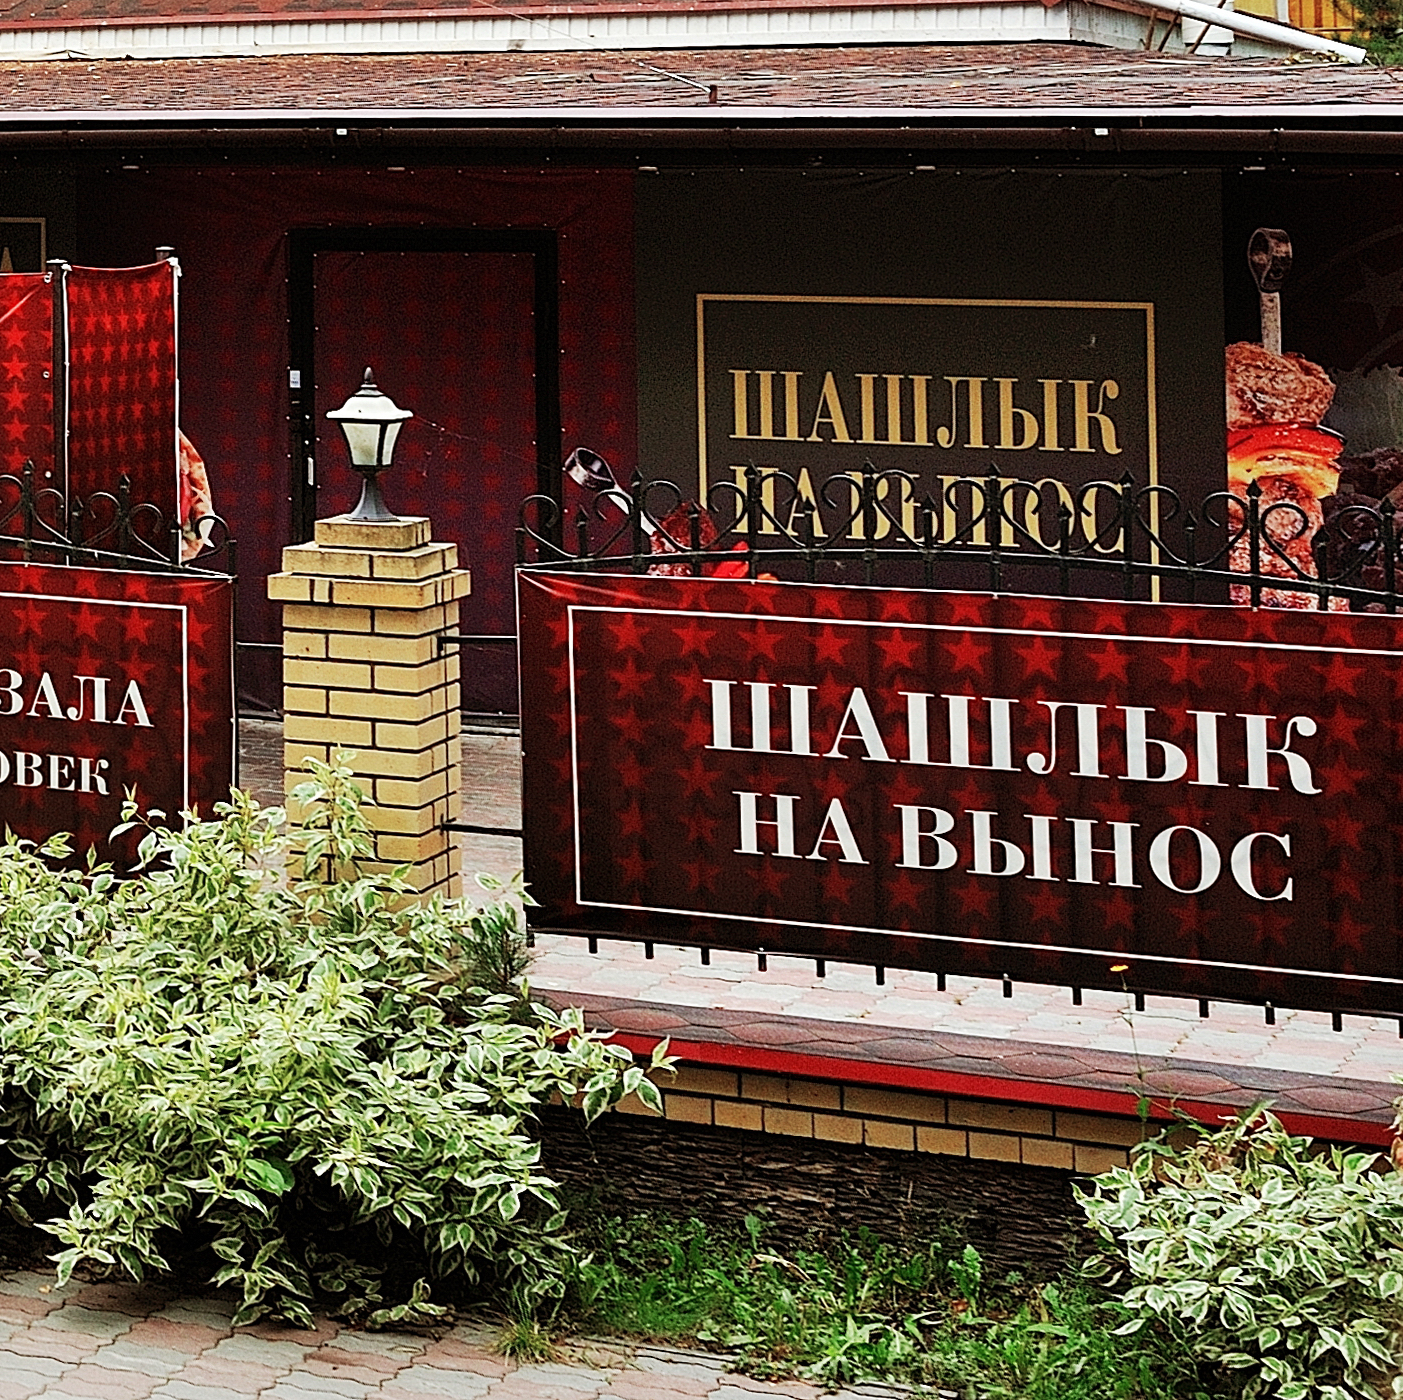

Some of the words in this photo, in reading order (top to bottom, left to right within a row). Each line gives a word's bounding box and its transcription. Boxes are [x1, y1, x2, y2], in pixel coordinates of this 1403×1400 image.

[728, 369, 1124, 456] ШАШЛЫК
[701, 678, 1324, 796] ШАШЛЫК
[731, 789, 870, 866] НА
[892, 803, 1294, 902] ВЫНОС
